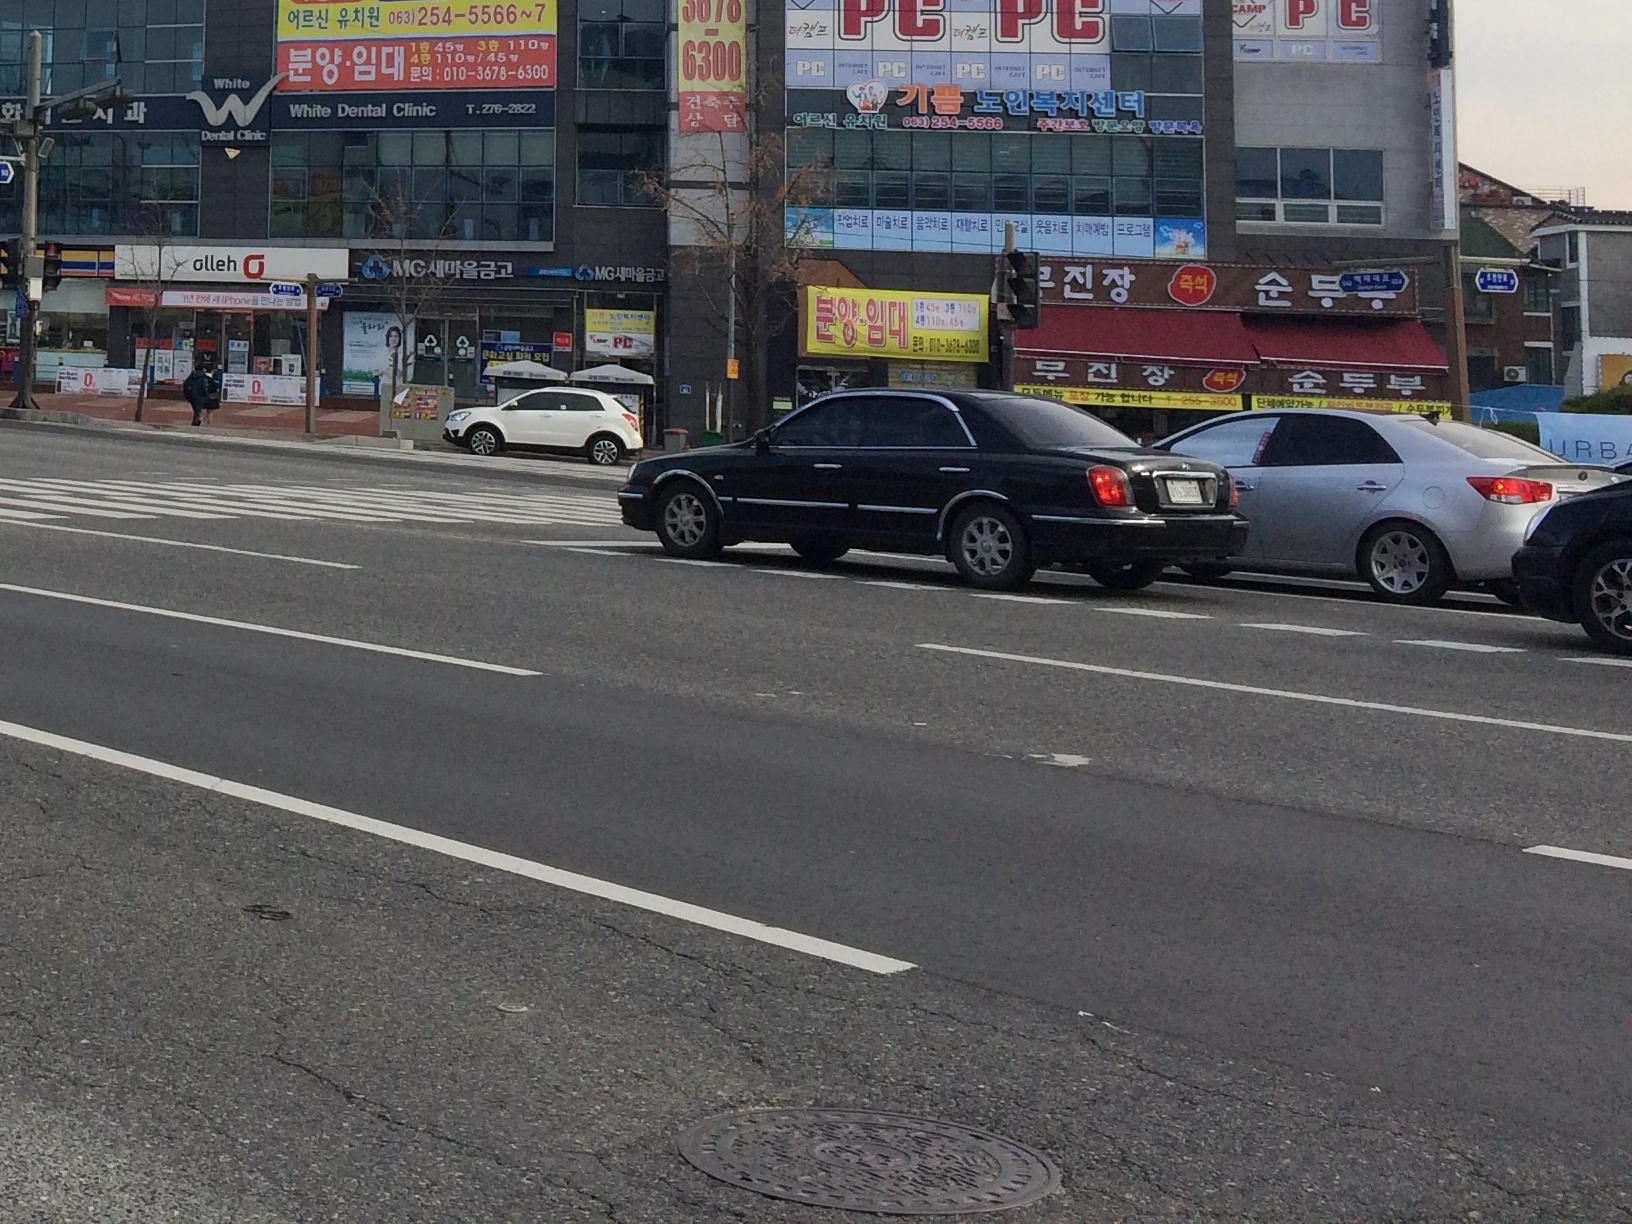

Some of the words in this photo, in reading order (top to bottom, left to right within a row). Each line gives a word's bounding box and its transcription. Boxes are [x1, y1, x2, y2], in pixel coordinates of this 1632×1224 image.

[287, 7, 329, 30] 어르신
[337, 7, 380, 29] 유치원
[682, 40, 742, 81] 6300
[796, 60, 826, 77] PC
[877, 60, 907, 78] PC
[443, 65, 549, 82] 010-3678-6300
[955, 63, 986, 79] PC
[1035, 64, 1066, 81] PC
[214, 78, 250, 90] White
[895, 83, 964, 115] 기쁨
[974, 89, 1145, 118] 노인복지센터
[289, 103, 332, 118] White
[337, 103, 386, 118] Dental
[392, 102, 437, 117] Clinic
[466, 103, 536, 115] T.276-2822
[793, 112, 837, 129] 어르신
[843, 114, 888, 129] 유치원
[1037, 118, 1090, 132] 주간보호
[1092, 119, 1145, 133] 방문요양
[201, 130, 234, 142] Dental
[236, 129, 266, 141] Clinic
[877, 215, 908, 230] 미술치료
[916, 216, 949, 231] 음악치료
[1036, 221, 1069, 234] 웃음치료
[1118, 223, 1151, 237] 프로그램
[193, 254, 237, 273] olleh
[392, 259, 514, 279] MG새마을금고
[595, 266, 665, 282] MG새마을금고
[1179, 274, 1208, 294] 즉석
[613, 336, 633, 349] PC
[1032, 360, 1175, 386] 무진장
[1288, 370, 1426, 396] 순두부
